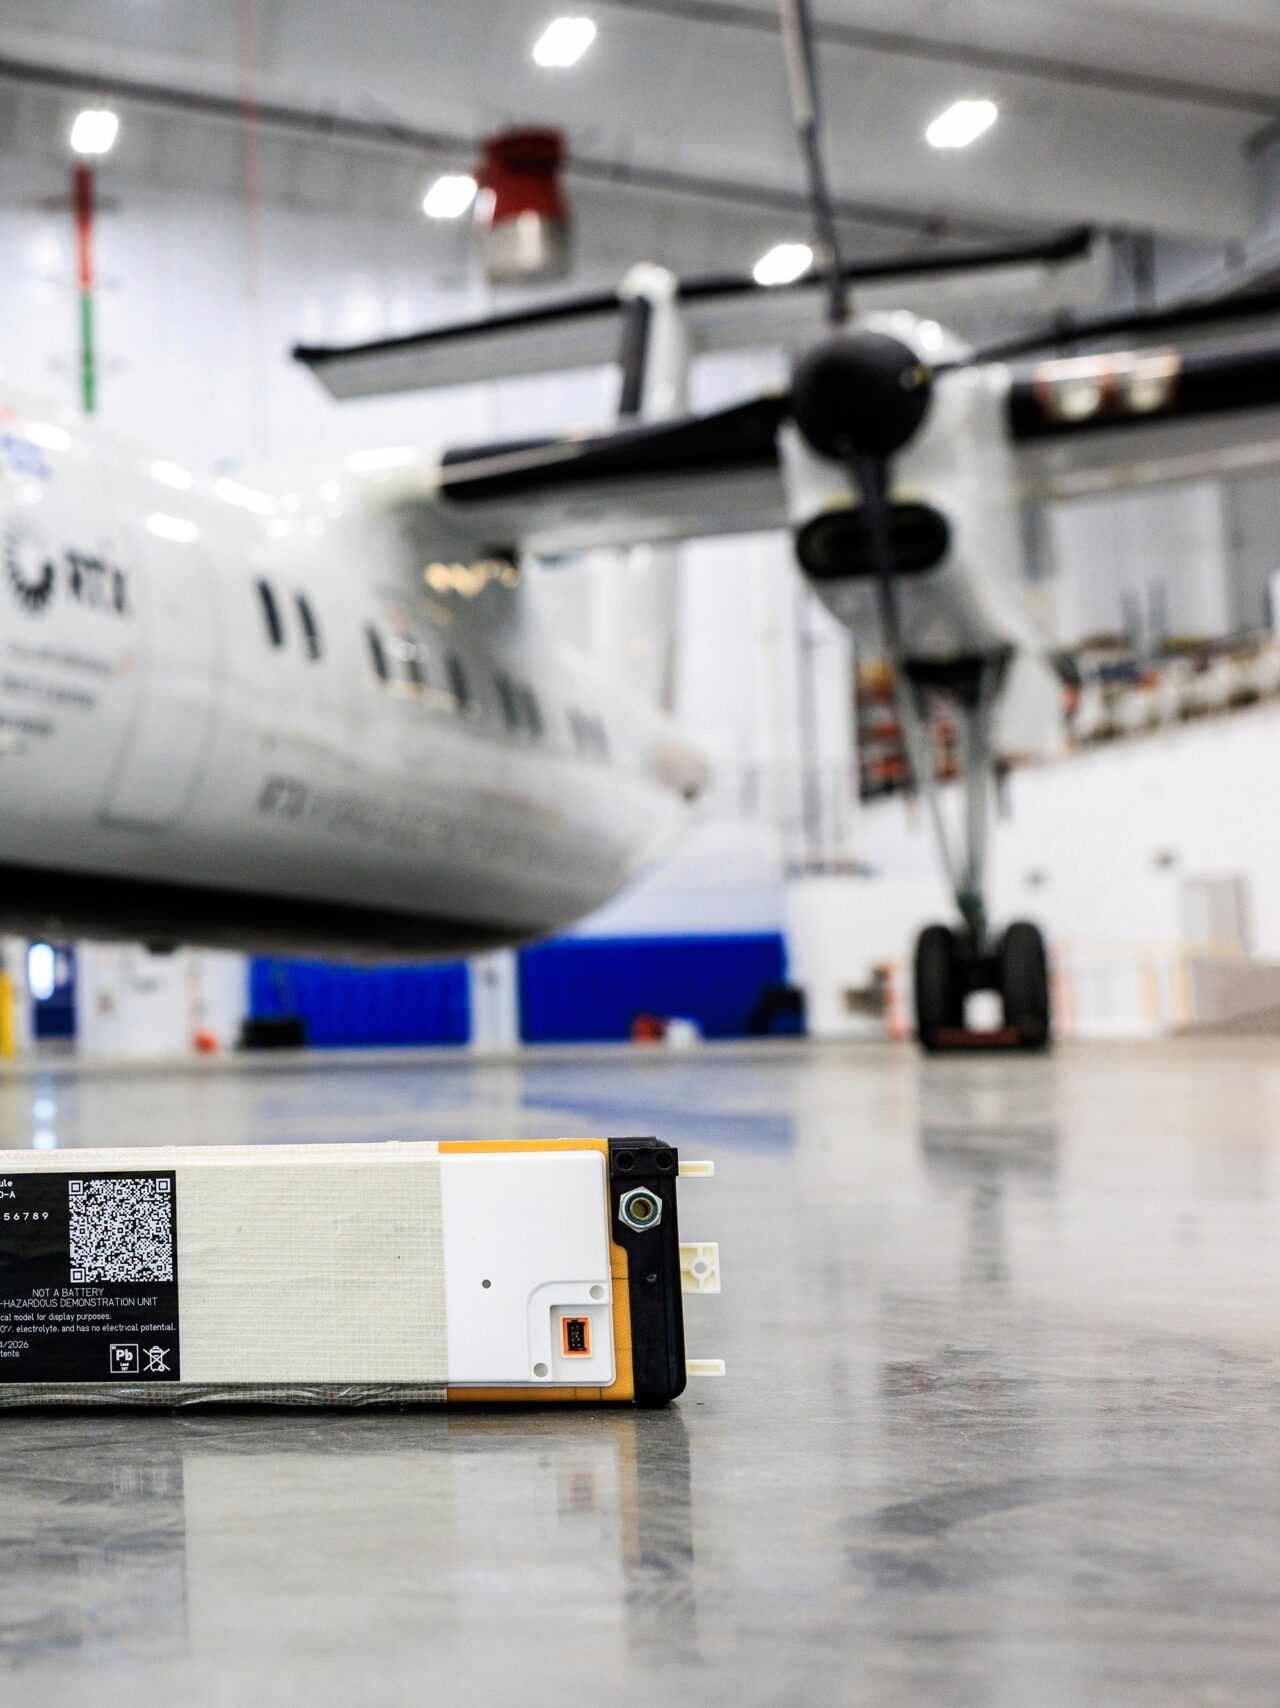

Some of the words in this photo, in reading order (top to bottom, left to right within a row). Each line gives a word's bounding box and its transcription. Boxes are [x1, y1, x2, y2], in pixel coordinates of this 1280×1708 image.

[32, 1288, 51, 1298] NOT
[53, 1288, 60, 1297] A
[61, 1287, 104, 1297] BATTERY
[60, 1297, 136, 1308] DEMONSTRATION
[137, 1296, 158, 1307] UNIT
[13, 1312, 35, 1321] model
[36, 1312, 47, 1320] for
[48, 1312, 75, 1323] display
[76, 1313, 112, 1321] purposes.
[61, 1324, 75, 1333] and
[76, 1324, 90, 1332] has
[91, 1324, 101, 1332] no
[101, 1323, 139, 1332] electrical
[140, 1322, 177, 1333] potential.
[115, 1348, 134, 1361] Pb
